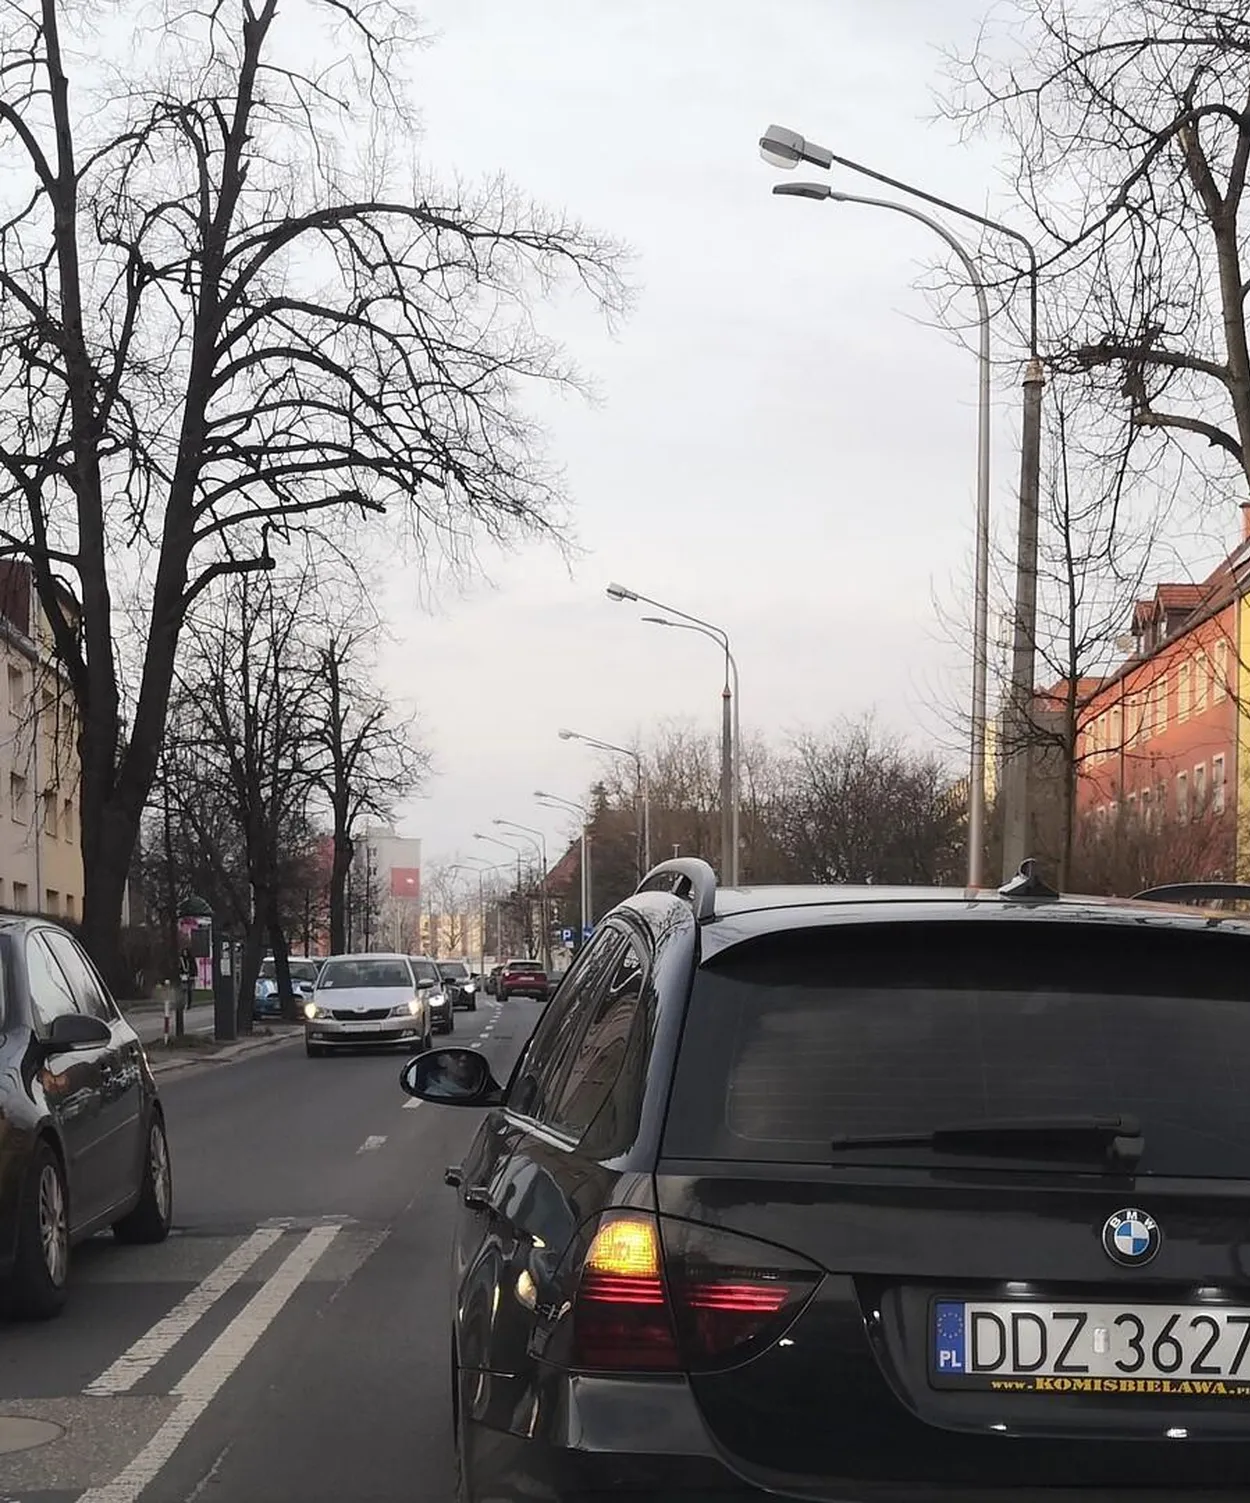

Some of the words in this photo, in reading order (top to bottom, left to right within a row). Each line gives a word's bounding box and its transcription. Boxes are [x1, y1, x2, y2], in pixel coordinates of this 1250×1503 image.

[563, 930, 571, 940] P
[1110, 1211, 1156, 1230] BMW
[971, 1312, 1090, 1373] DDZ
[940, 1350, 962, 1367] PL
